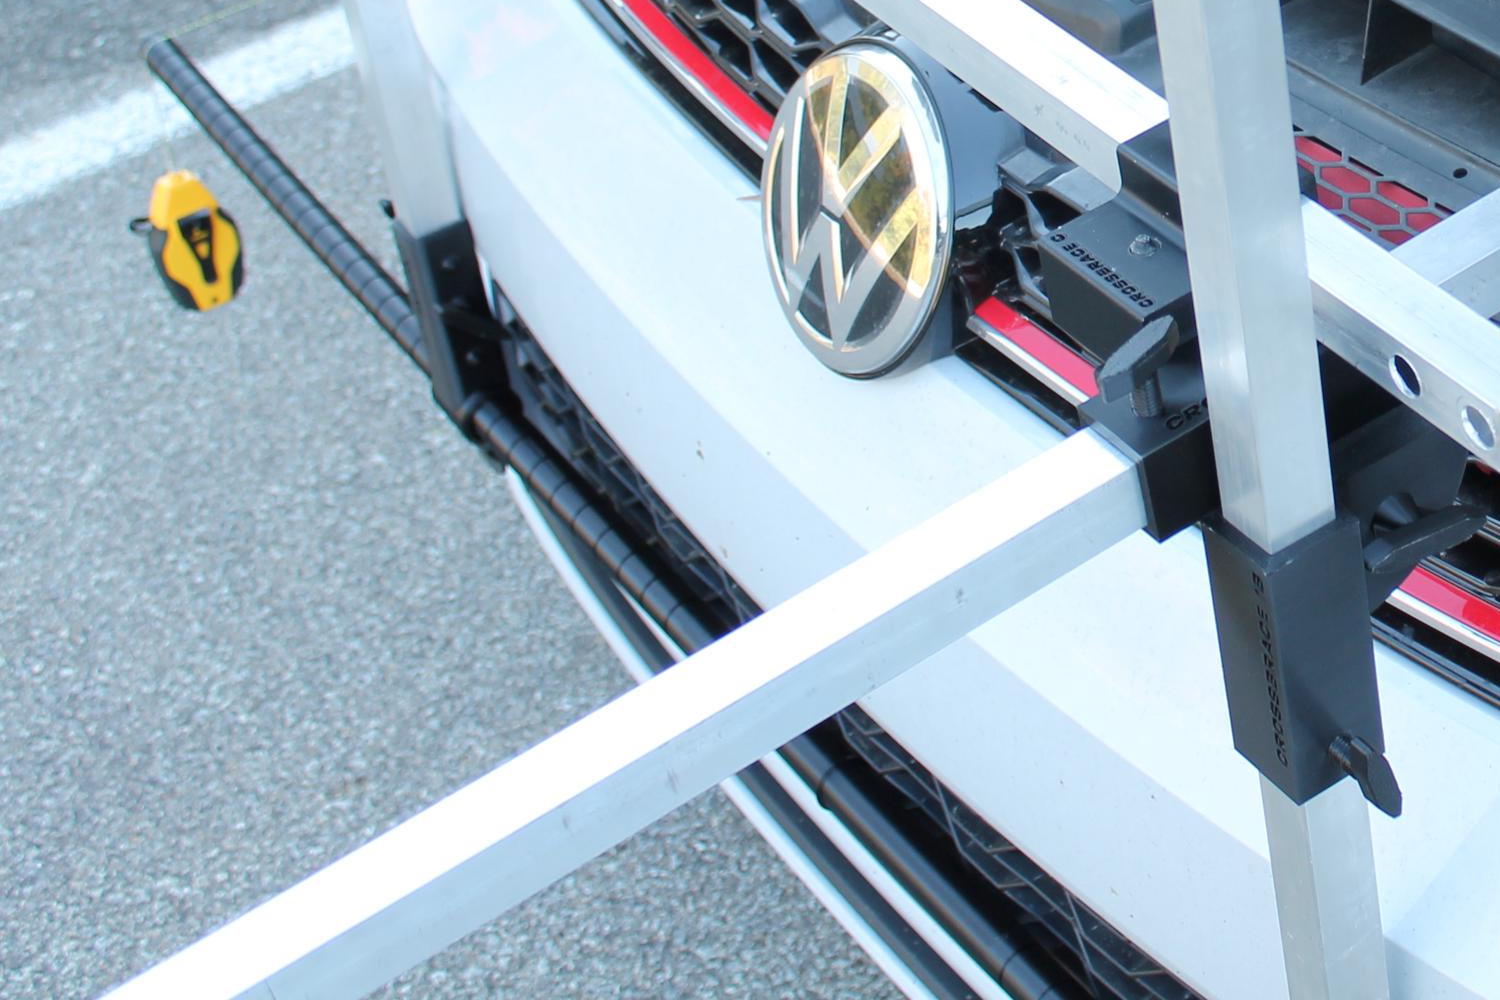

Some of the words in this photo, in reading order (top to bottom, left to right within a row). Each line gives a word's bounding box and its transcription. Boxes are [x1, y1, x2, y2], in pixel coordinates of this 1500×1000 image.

[1049, 233, 1067, 243] C
[1061, 243, 1155, 308] CROSSERACE
[1255, 607, 1290, 767] CROSSERACE
